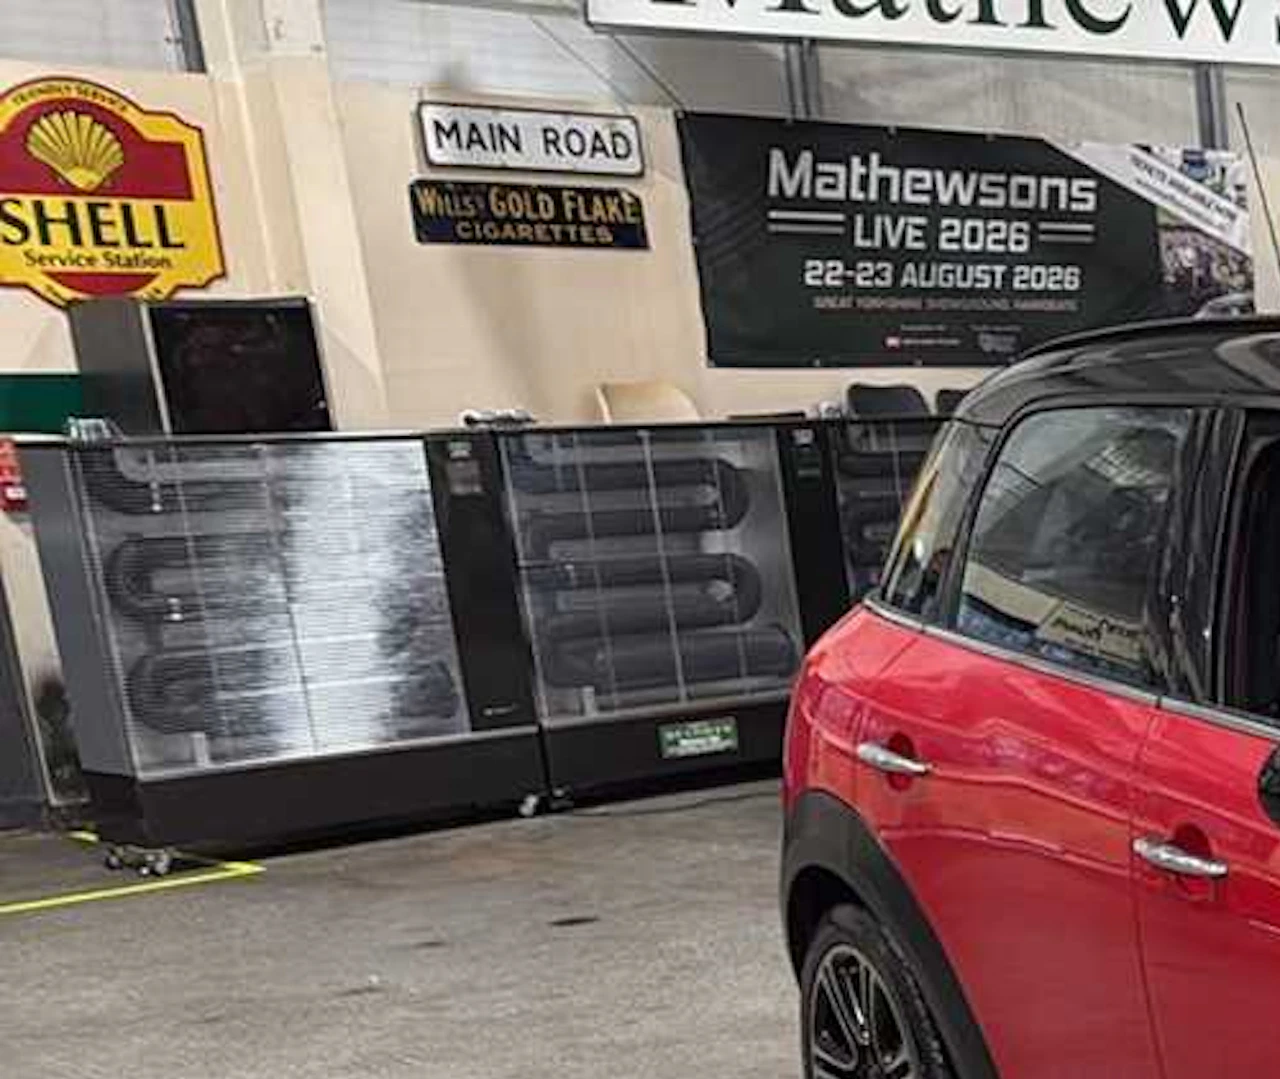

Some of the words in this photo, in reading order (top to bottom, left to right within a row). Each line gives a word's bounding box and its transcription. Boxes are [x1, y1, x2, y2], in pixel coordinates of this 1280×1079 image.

[433, 120, 523, 153] MAIN
[541, 127, 632, 160] ROAD
[767, 149, 1097, 211] Mathewsons
[0, 200, 185, 248] SHELL
[488, 185, 555, 221] GOLD
[562, 189, 642, 224] FLAKE
[454, 219, 614, 243] CIGARETTES
[853, 213, 928, 249] LIVE
[937, 218, 1030, 253] 2026
[23, 250, 99, 268] Service
[102, 251, 172, 269] Station
[803, 258, 894, 289] 22-23
[900, 261, 1007, 289] AUGUST
[1012, 265, 1081, 291] 2026
